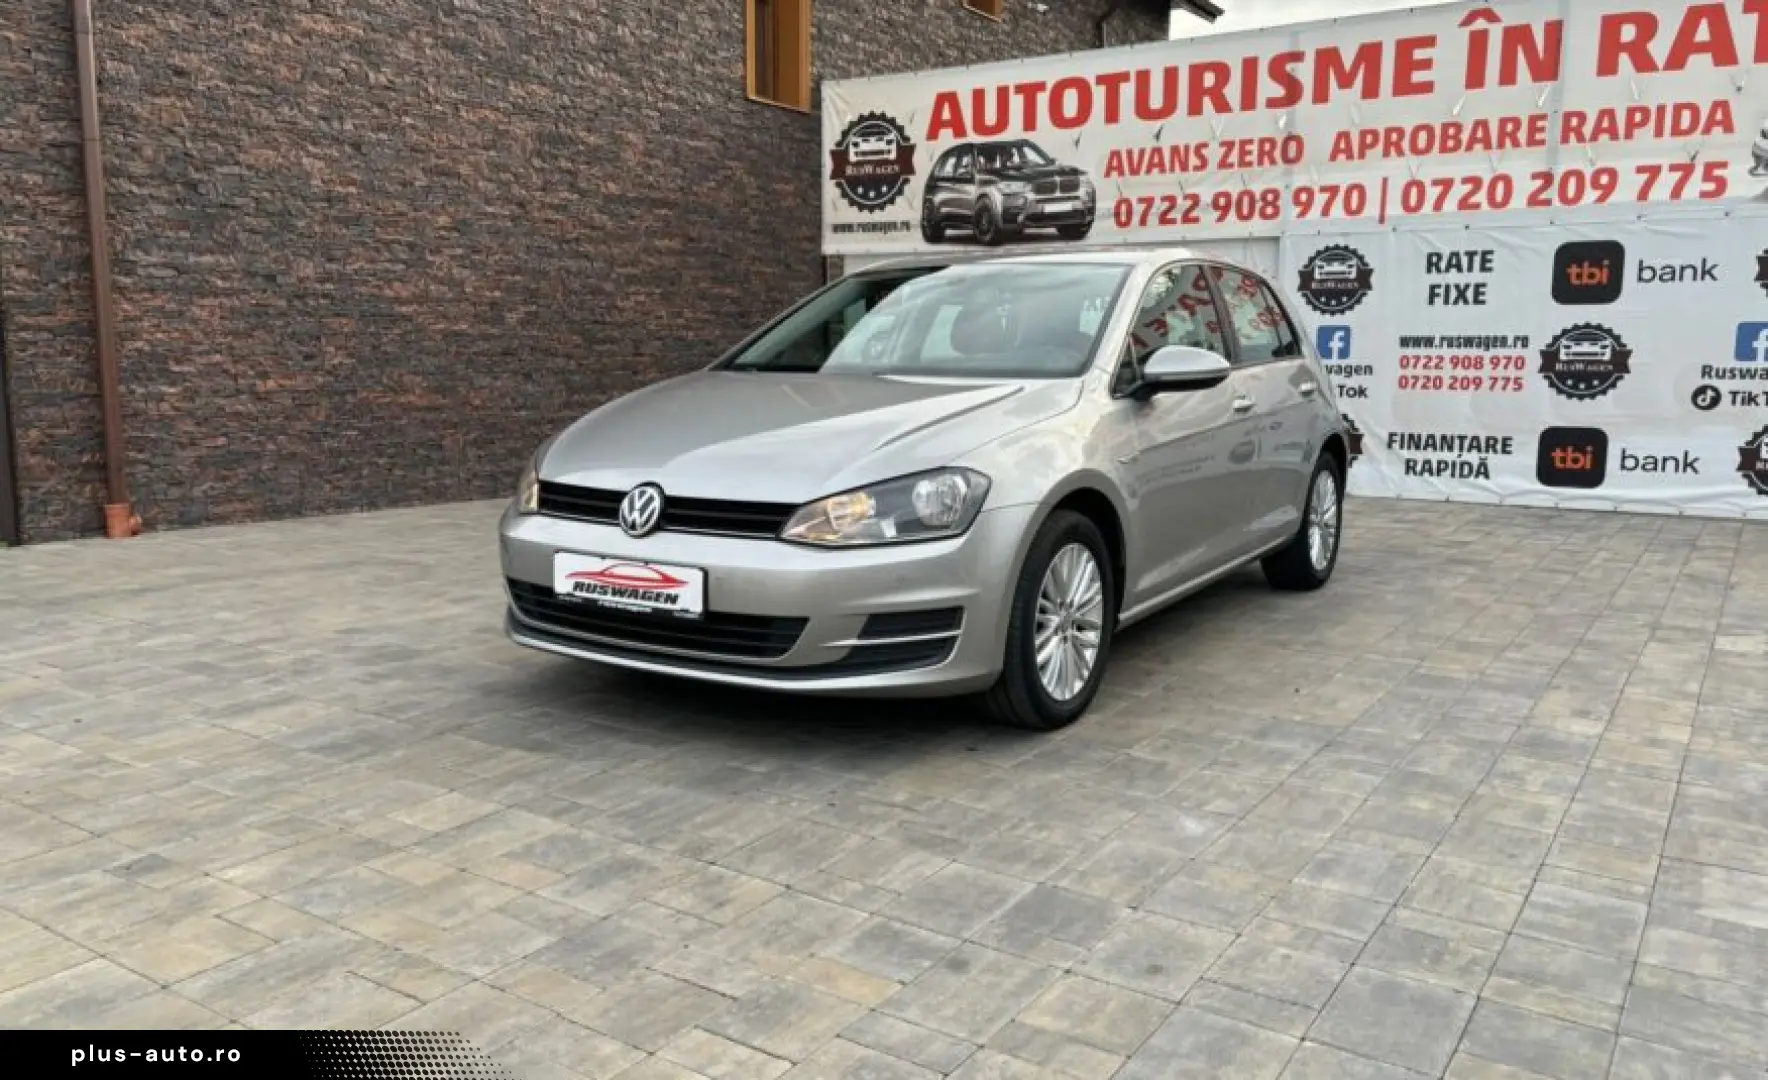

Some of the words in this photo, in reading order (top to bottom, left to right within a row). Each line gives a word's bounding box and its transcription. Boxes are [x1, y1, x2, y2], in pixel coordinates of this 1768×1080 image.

[926, 35, 1437, 142] AUTOTURISME
[1459, 8, 1564, 92] ÎN
[1103, 142, 1210, 179] AVANS
[1217, 135, 1306, 169] ZERO
[1328, 112, 1549, 162] APROBARE
[1559, 100, 1736, 145] RAPIDA
[1112, 193, 1202, 229] 0722
[1210, 188, 1282, 224] 908
[1291, 183, 1368, 219] 970
[1401, 173, 1515, 214] 0720
[1525, 167, 1620, 208] 209
[1634, 161, 1730, 201] 775
[1426, 250, 1494, 274] RATE
[1566, 263, 1610, 286] tbi
[1638, 257, 1719, 283] bank
[1428, 282, 1487, 306] FIXE
[1399, 335, 1529, 351] www.ruswagen.ro
[1399, 354, 1444, 370] 0722
[1449, 354, 1484, 370] 908
[1489, 355, 1526, 371] 970
[1701, 364, 1768, 380] Ruswa
[1399, 374, 1443, 390] 0720
[1448, 375, 1483, 391] 209
[1489, 376, 1524, 391] 775
[1404, 456, 1490, 479] RAPIDĂ
[1550, 445, 1594, 470] tbi
[1620, 449, 1700, 474] bank
[572, 580, 679, 605] RUSWAGEN
